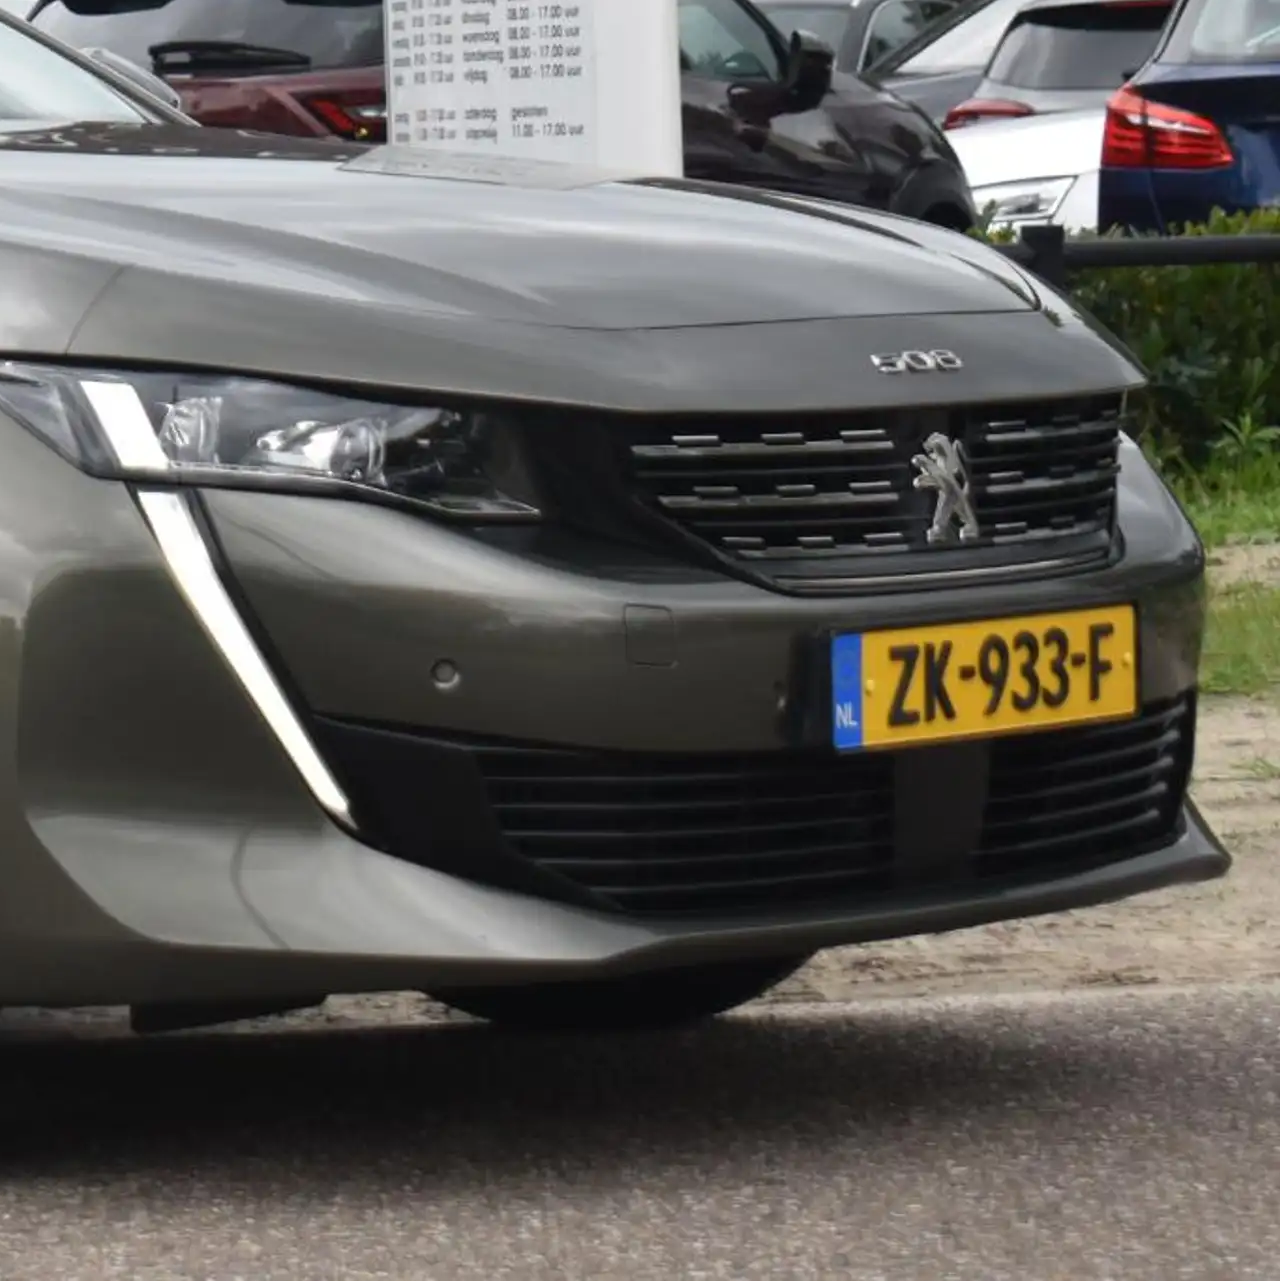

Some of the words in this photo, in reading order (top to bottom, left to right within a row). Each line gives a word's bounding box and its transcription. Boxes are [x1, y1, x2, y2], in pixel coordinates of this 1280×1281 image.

[870, 348, 963, 373] 508
[888, 622, 1115, 729] ZK-933-F
[835, 701, 858, 729] NL
